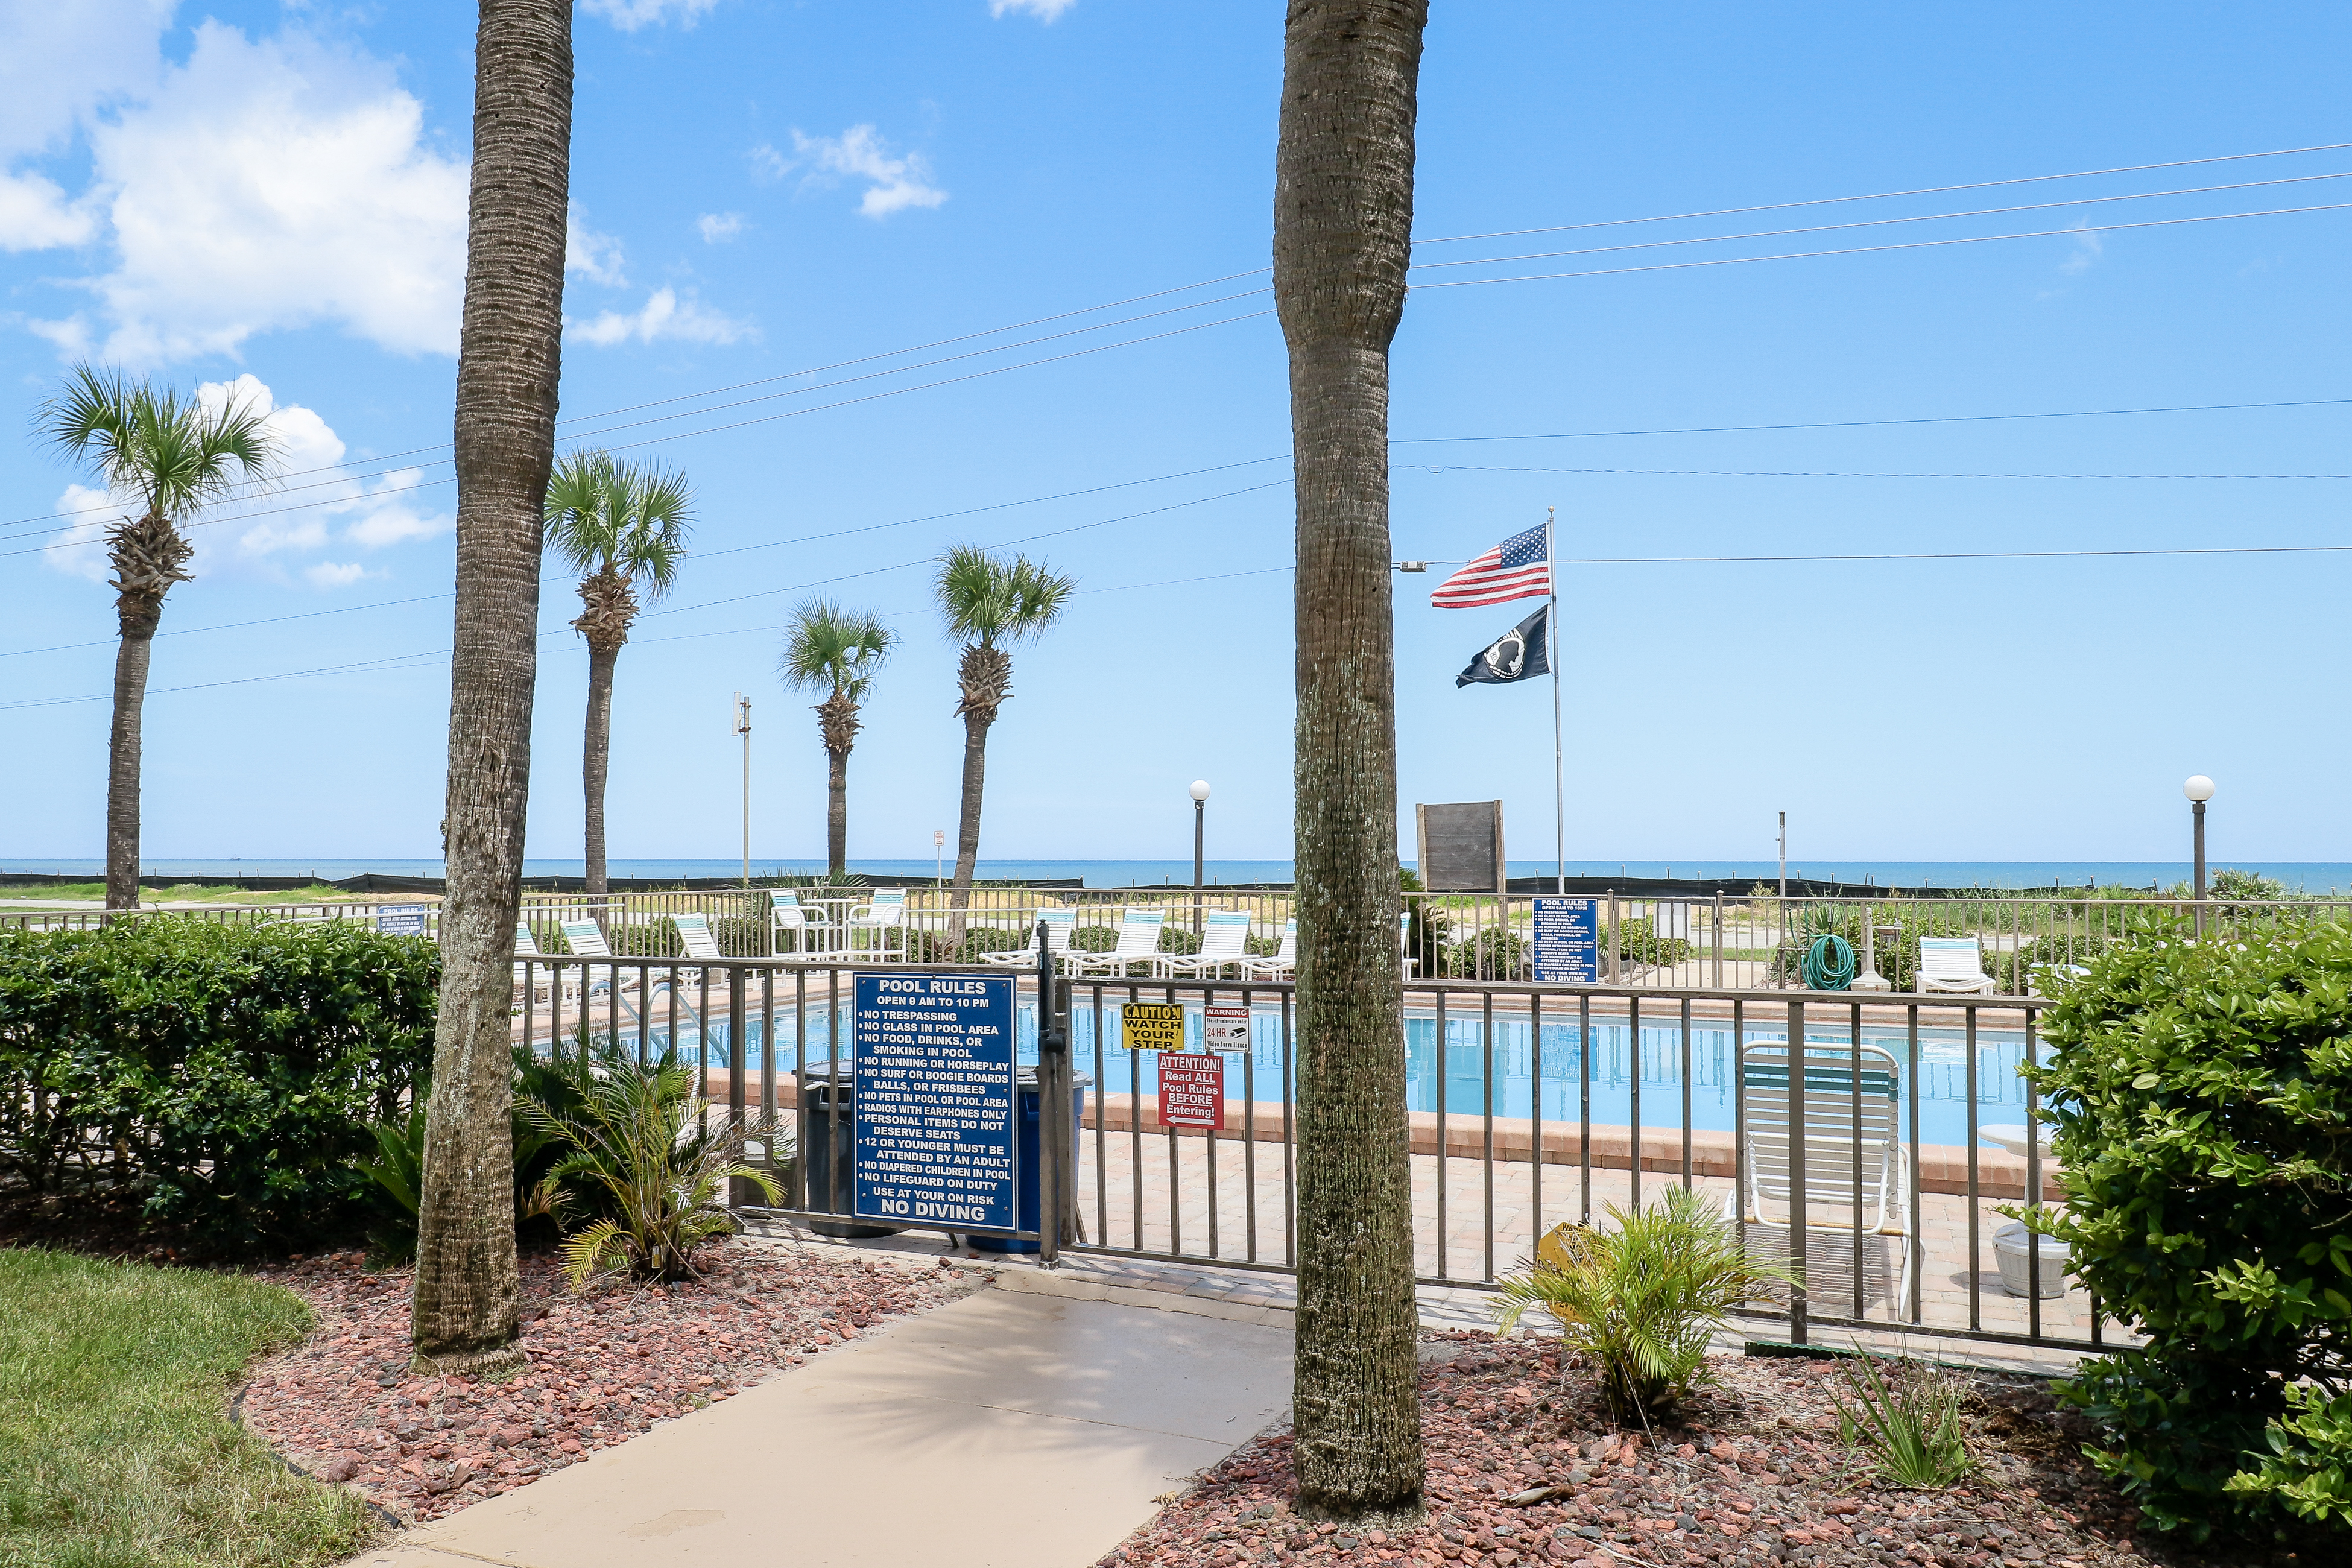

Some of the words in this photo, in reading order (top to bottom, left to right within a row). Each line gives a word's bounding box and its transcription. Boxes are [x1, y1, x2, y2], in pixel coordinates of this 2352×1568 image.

[879, 979, 925, 992] POOL
[930, 981, 985, 994] RULES
[877, 996, 906, 1005] OPEN
[909, 996, 915, 1005] 9
[918, 997, 935, 1005] AM
[938, 997, 953, 1006] TO
[956, 997, 969, 1007] 10
[972, 999, 988, 1007] PM
[864, 1010, 879, 1019] NO
[882, 1010, 956, 1021] TRESPASSING
[1124, 1006, 1180, 1019] CAUTION
[864, 1022, 879, 1030] NO
[882, 1022, 917, 1031] GLASS
[920, 1023, 932, 1032] IN
[935, 1024, 965, 1033] POOL
[967, 1025, 999, 1034] AREA
[1124, 1020, 1181, 1029] WATCH
[1131, 1029, 1175, 1039] YOUR
[1207, 1028, 1215, 1037] 24
[1217, 1028, 1226, 1037] HR
[864, 1033, 879, 1042] NO
[882, 1034, 914, 1045] FOOD,
[918, 1035, 963, 1047] DRINKS,
[966, 1037, 982, 1046] OR
[1133, 1040, 1172, 1049] STEP
[873, 1045, 923, 1055] SMOKING
[927, 1047, 938, 1056] IN
[942, 1048, 972, 1057] POOL
[864, 1056, 878, 1065] NO
[881, 1057, 927, 1067] RUNNING
[930, 1059, 944, 1068] OR
[947, 1060, 1008, 1071] HORSEPLAY
[1160, 1055, 1220, 1070] ATTENTION!
[864, 1068, 878, 1076] NO
[880, 1069, 906, 1078] SURF
[909, 1070, 923, 1079] OR
[925, 1070, 964, 1081] BOOGIE
[967, 1073, 1008, 1083] BOARDS
[1165, 1071, 1192, 1081] Read
[1195, 1073, 1216, 1083] ALL
[873, 1080, 909, 1092] BALLS,
[913, 1082, 929, 1091] OR
[932, 1083, 985, 1094] FRISBEES
[1163, 1082, 1185, 1092] Pool
[1189, 1084, 1218, 1095] Rules
[864, 1091, 876, 1100] NO
[879, 1092, 900, 1101] PETS
[903, 1093, 912, 1102] IN
[915, 1094, 938, 1103] POOL
[941, 1095, 953, 1104] OR
[956, 1096, 981, 1105] POOL
[982, 1098, 1008, 1107] AREA
[1169, 1093, 1212, 1104] BEFORE
[864, 1103, 896, 1113] RADIOS
[899, 1105, 922, 1114] WITH
[924, 1106, 979, 1118] EARPHONES
[981, 1110, 1007, 1119] ONLY
[1166, 1104, 1215, 1119] Entering!
[864, 1113, 921, 1125] PERSONAL
[924, 1117, 958, 1128] ITEMS
[961, 1119, 976, 1128] DO
[980, 1121, 1004, 1130] NOT
[873, 1126, 922, 1137] DESERVE
[925, 1129, 960, 1140] SEATS
[864, 1137, 876, 1146] 12
[879, 1138, 895, 1147] OR
[897, 1139, 950, 1151] YOUNGER
[953, 1143, 985, 1153] MUST
[989, 1145, 1004, 1155] BE
[876, 1149, 933, 1162] ATTENDED
[937, 1154, 952, 1163] BY
[953, 1155, 969, 1165] AN
[972, 1157, 1010, 1167] ADULT
[864, 1160, 877, 1169] NO
[879, 1162, 922, 1172] DIAPERED
[925, 1165, 970, 1177] CHILDREN
[973, 1168, 982, 1177] IN
[985, 1169, 1010, 1180] POOL
[864, 1172, 879, 1181] NO
[883, 1174, 944, 1186] LIFEGUARD
[947, 1178, 963, 1188] ON
[967, 1180, 997, 1190] DUTY
[873, 1187, 894, 1197] USE
[897, 1189, 911, 1198] AT
[914, 1190, 944, 1201] YOUR
[947, 1193, 964, 1202] ON
[967, 1194, 994, 1204] RISK
[881, 1198, 909, 1214] NO
[915, 1201, 984, 1221] DIVING
